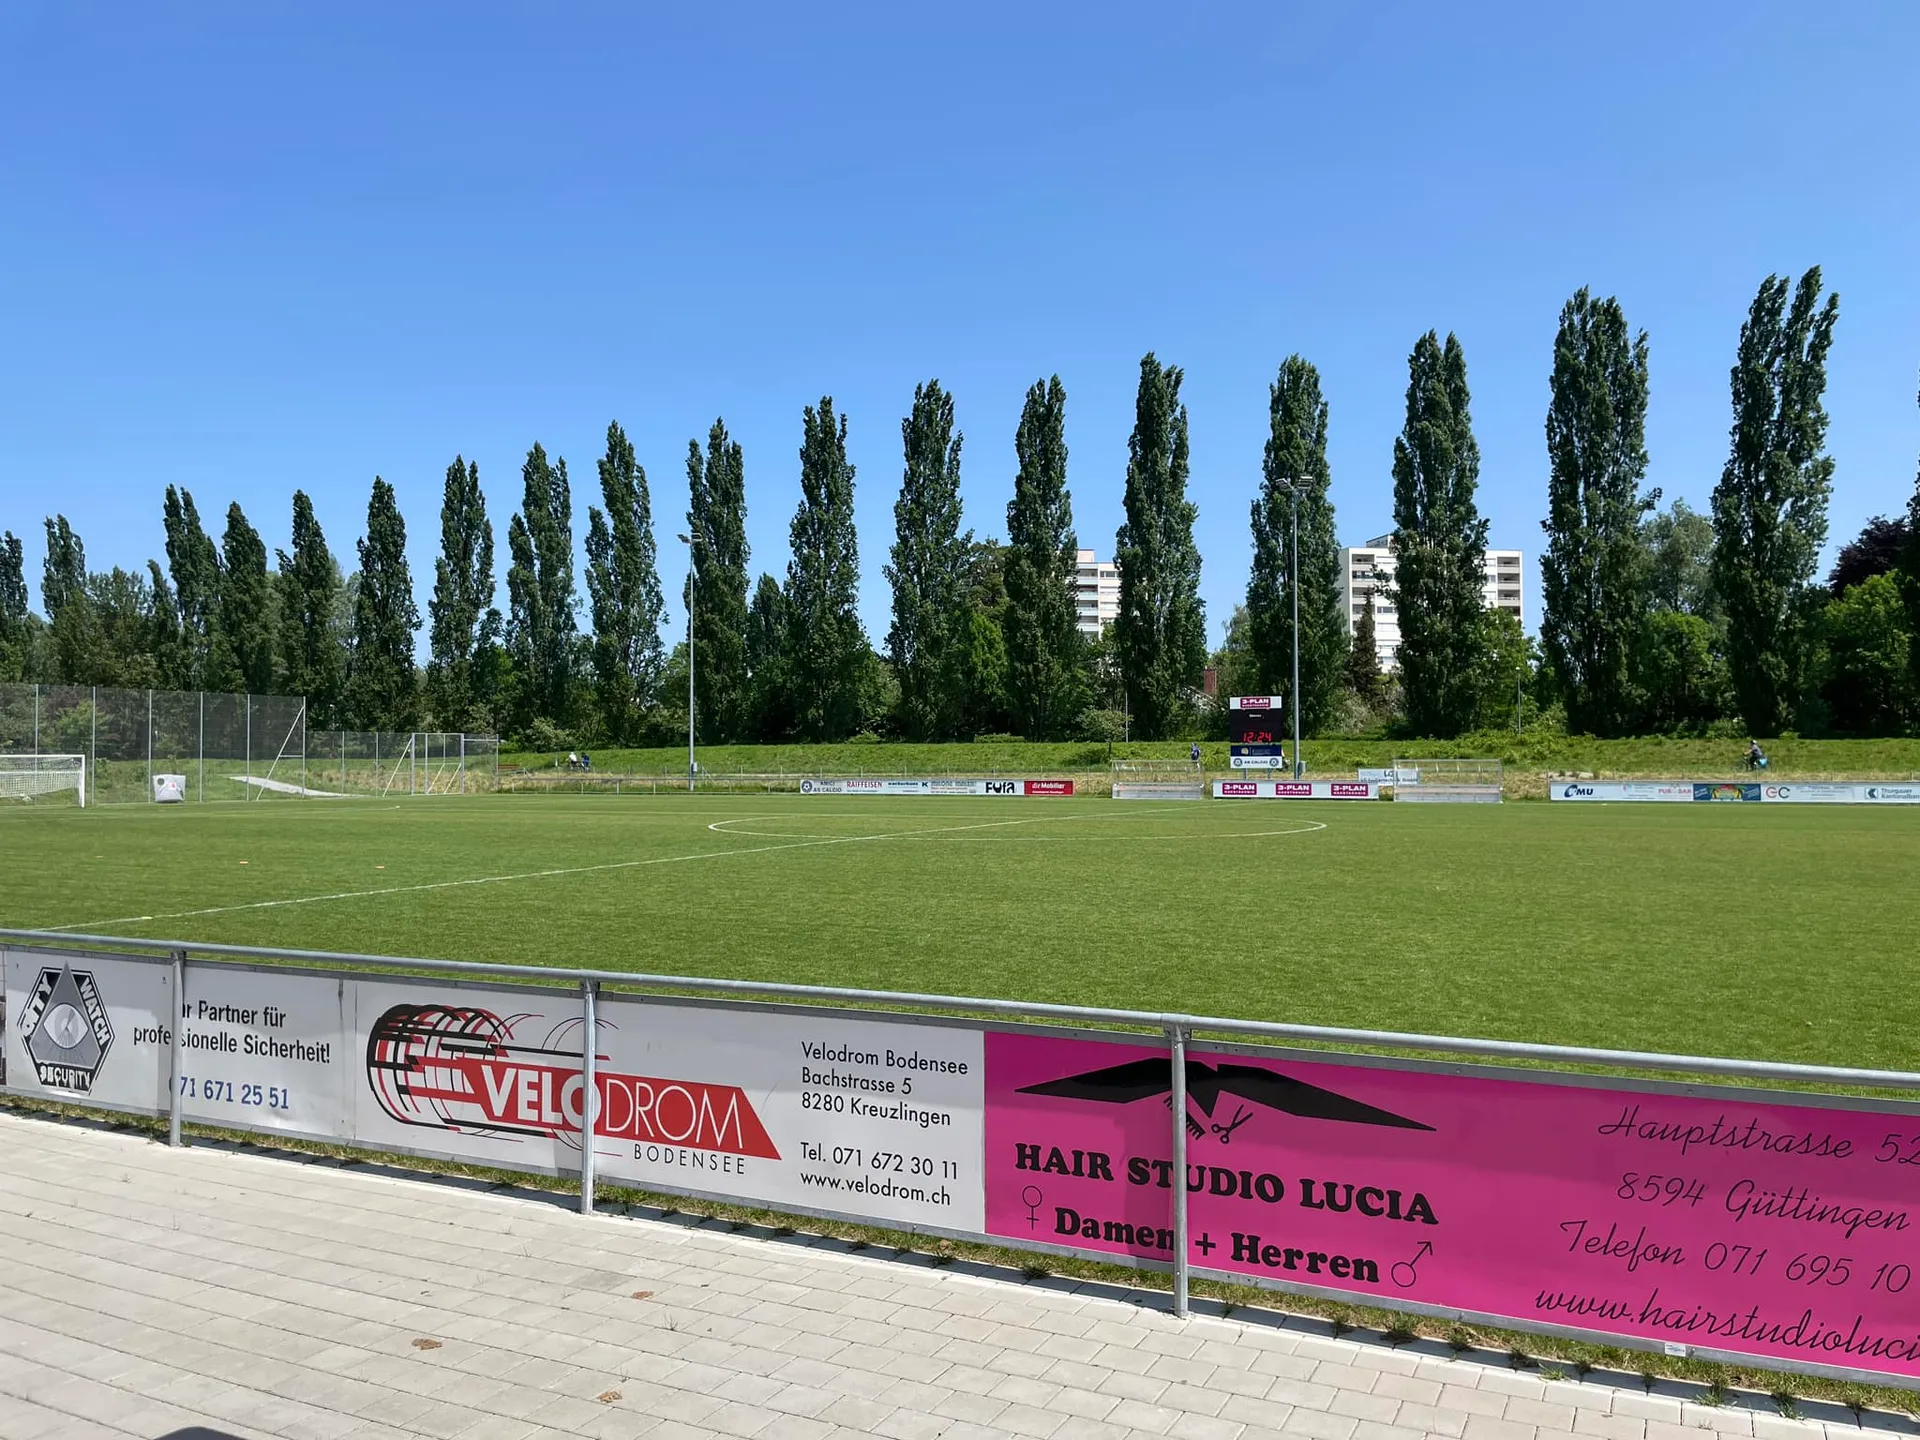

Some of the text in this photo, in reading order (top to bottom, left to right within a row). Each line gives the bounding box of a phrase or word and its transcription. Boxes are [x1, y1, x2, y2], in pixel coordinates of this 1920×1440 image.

[80, 977, 110, 1046] WATCH
[198, 1000, 258, 1025] Partner
[263, 1006, 286, 1028] für
[134, 1024, 330, 1064] profesionelle Sicherheit!
[801, 1041, 968, 1075] Velodrom Bodensee
[40, 1065, 91, 1089] SECURITY
[204, 1079, 234, 1102] 671
[241, 1083, 263, 1105] 25
[269, 1087, 290, 1109] 51
[802, 1066, 912, 1094] Bachstrasse 5
[481, 1064, 743, 1149] VELODROM
[802, 1091, 951, 1128] 8280 Kreuzlingen
[1598, 1104, 1854, 1159] Hauptstrasse
[634, 1143, 745, 1174] BODENSEE
[800, 1141, 957, 1179] Tel. 071 672 30 11
[800, 1172, 951, 1206] www.velodrom.ch
[1014, 1142, 1439, 1226] HAIR STUDIO LUCIA
[1617, 1172, 1911, 1239] 8594 Güttingen
[1054, 1206, 1379, 1283] Damen + Herren
[1560, 1219, 1911, 1293] Telefon 071 695 10
